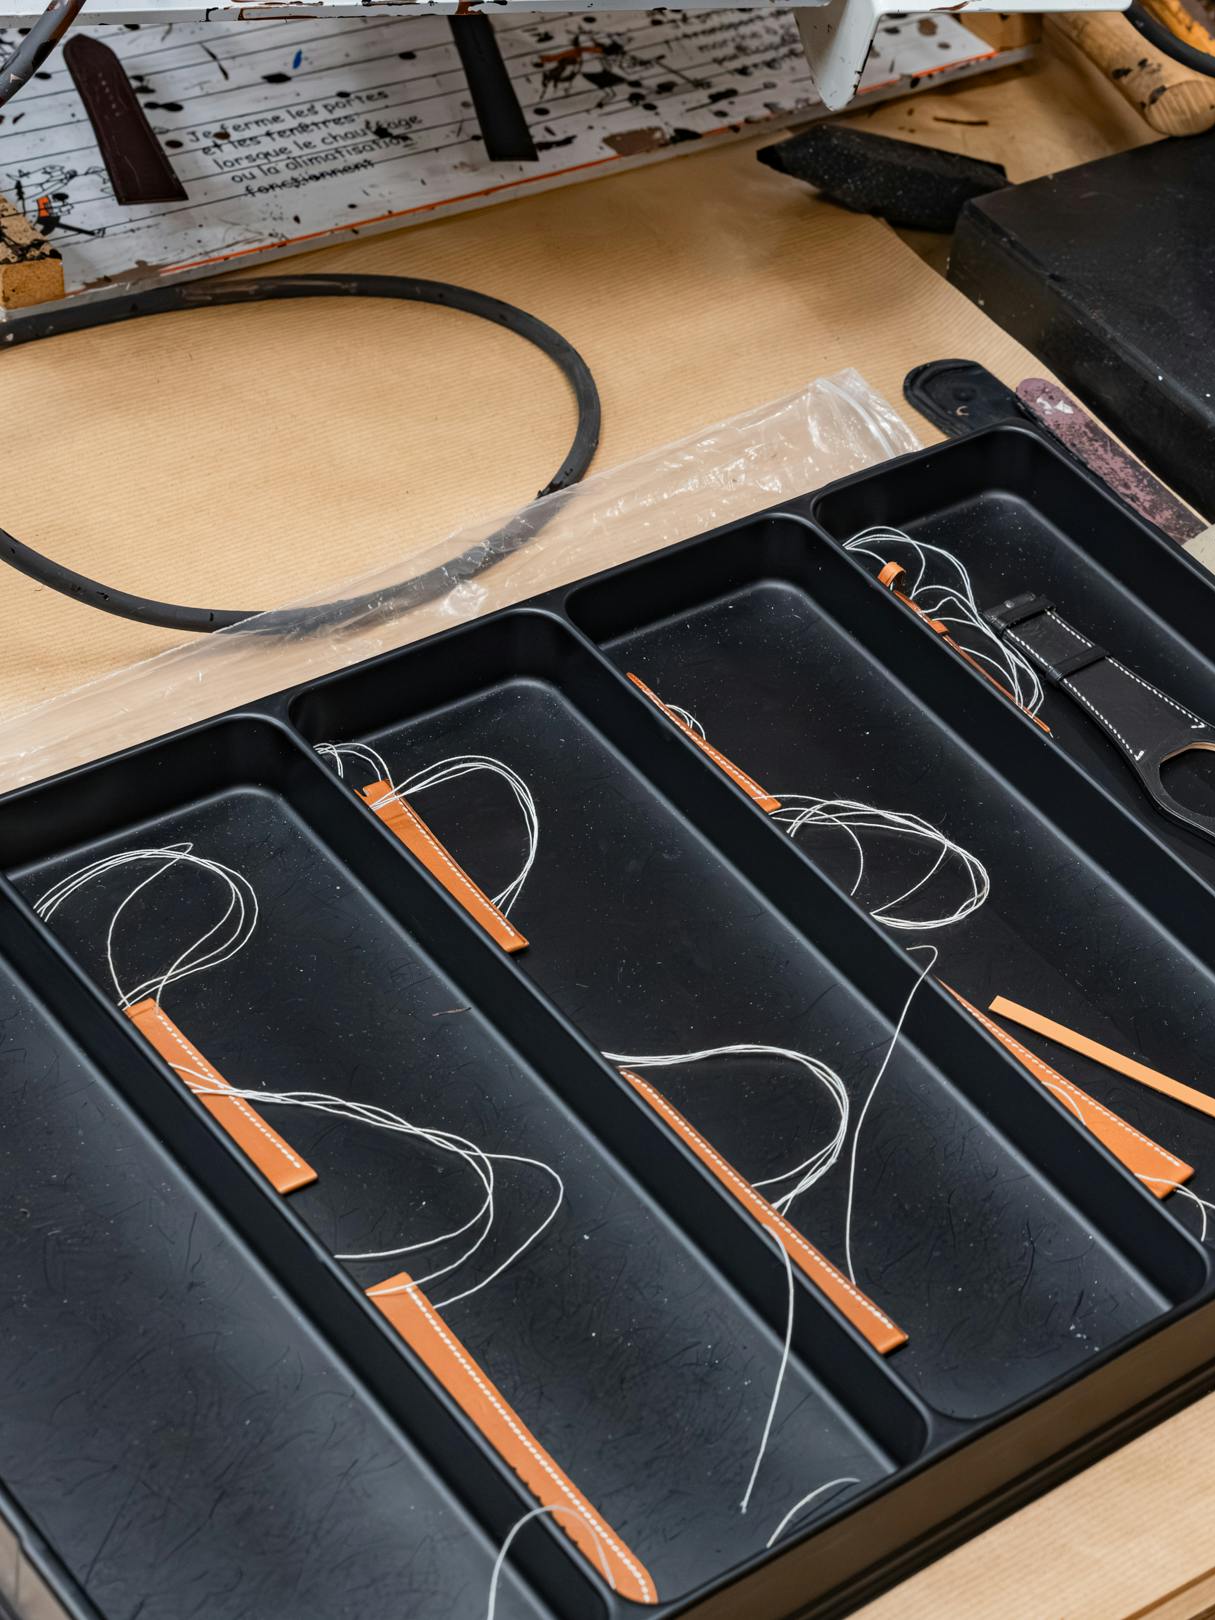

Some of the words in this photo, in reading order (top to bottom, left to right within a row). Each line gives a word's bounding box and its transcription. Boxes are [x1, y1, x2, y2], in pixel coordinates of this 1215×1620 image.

[187, 130, 213, 143] Je
[220, 114, 286, 137] ferme
[285, 104, 319, 121] les
[322, 90, 389, 115] portes
[202, 140, 224, 156] et
[229, 135, 262, 150] les
[212, 146, 293, 171] lorsque
[292, 140, 318, 152] le
[231, 171, 257, 184] ou
[256, 164, 281, 177] la
